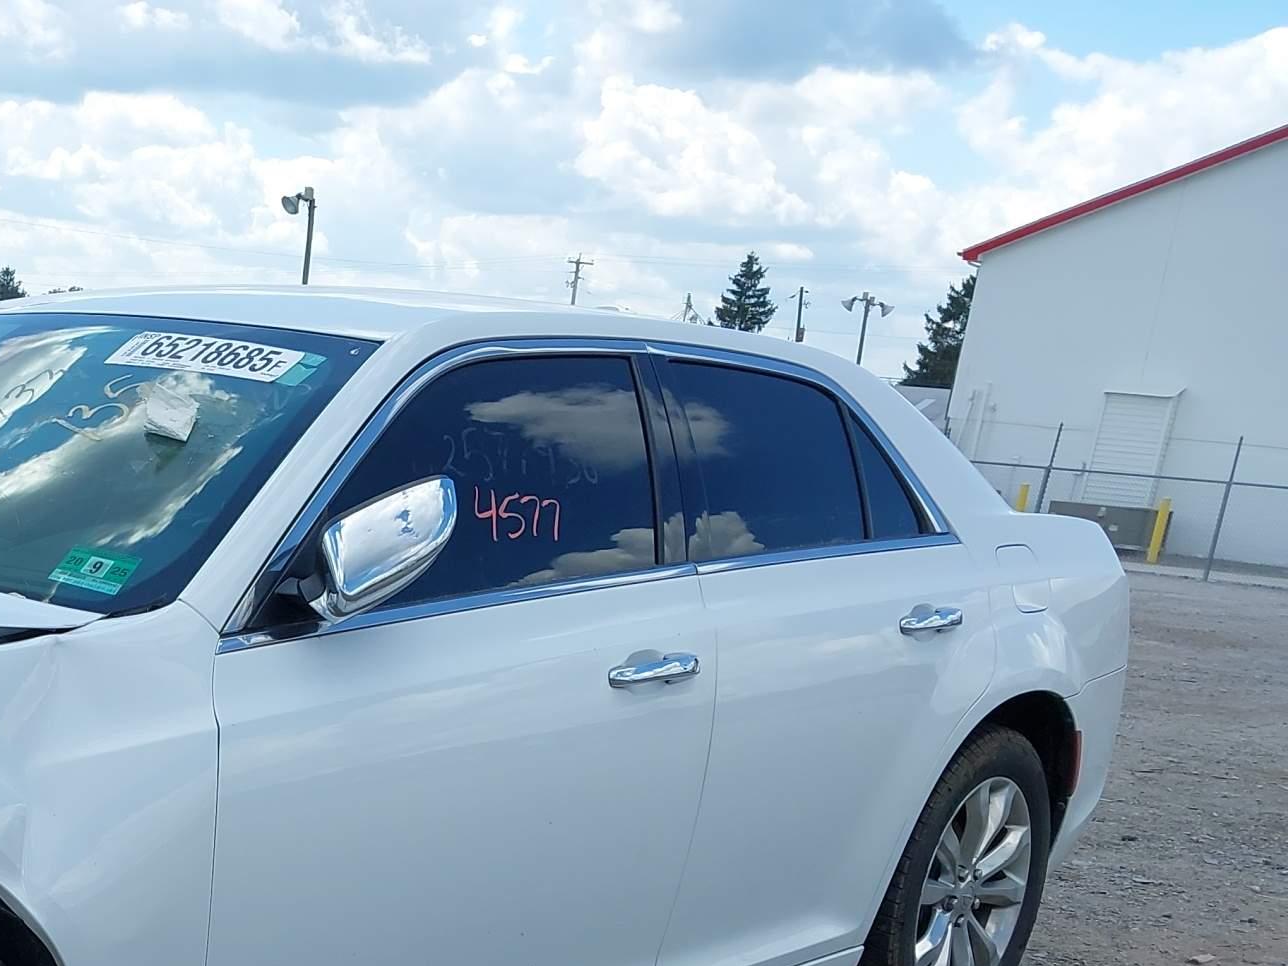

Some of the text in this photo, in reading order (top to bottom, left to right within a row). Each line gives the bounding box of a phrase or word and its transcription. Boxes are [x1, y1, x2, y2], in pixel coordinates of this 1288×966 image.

[140, 335, 283, 373] 65218685
[474, 486, 561, 542] 4577
[89, 560, 104, 574] 9
